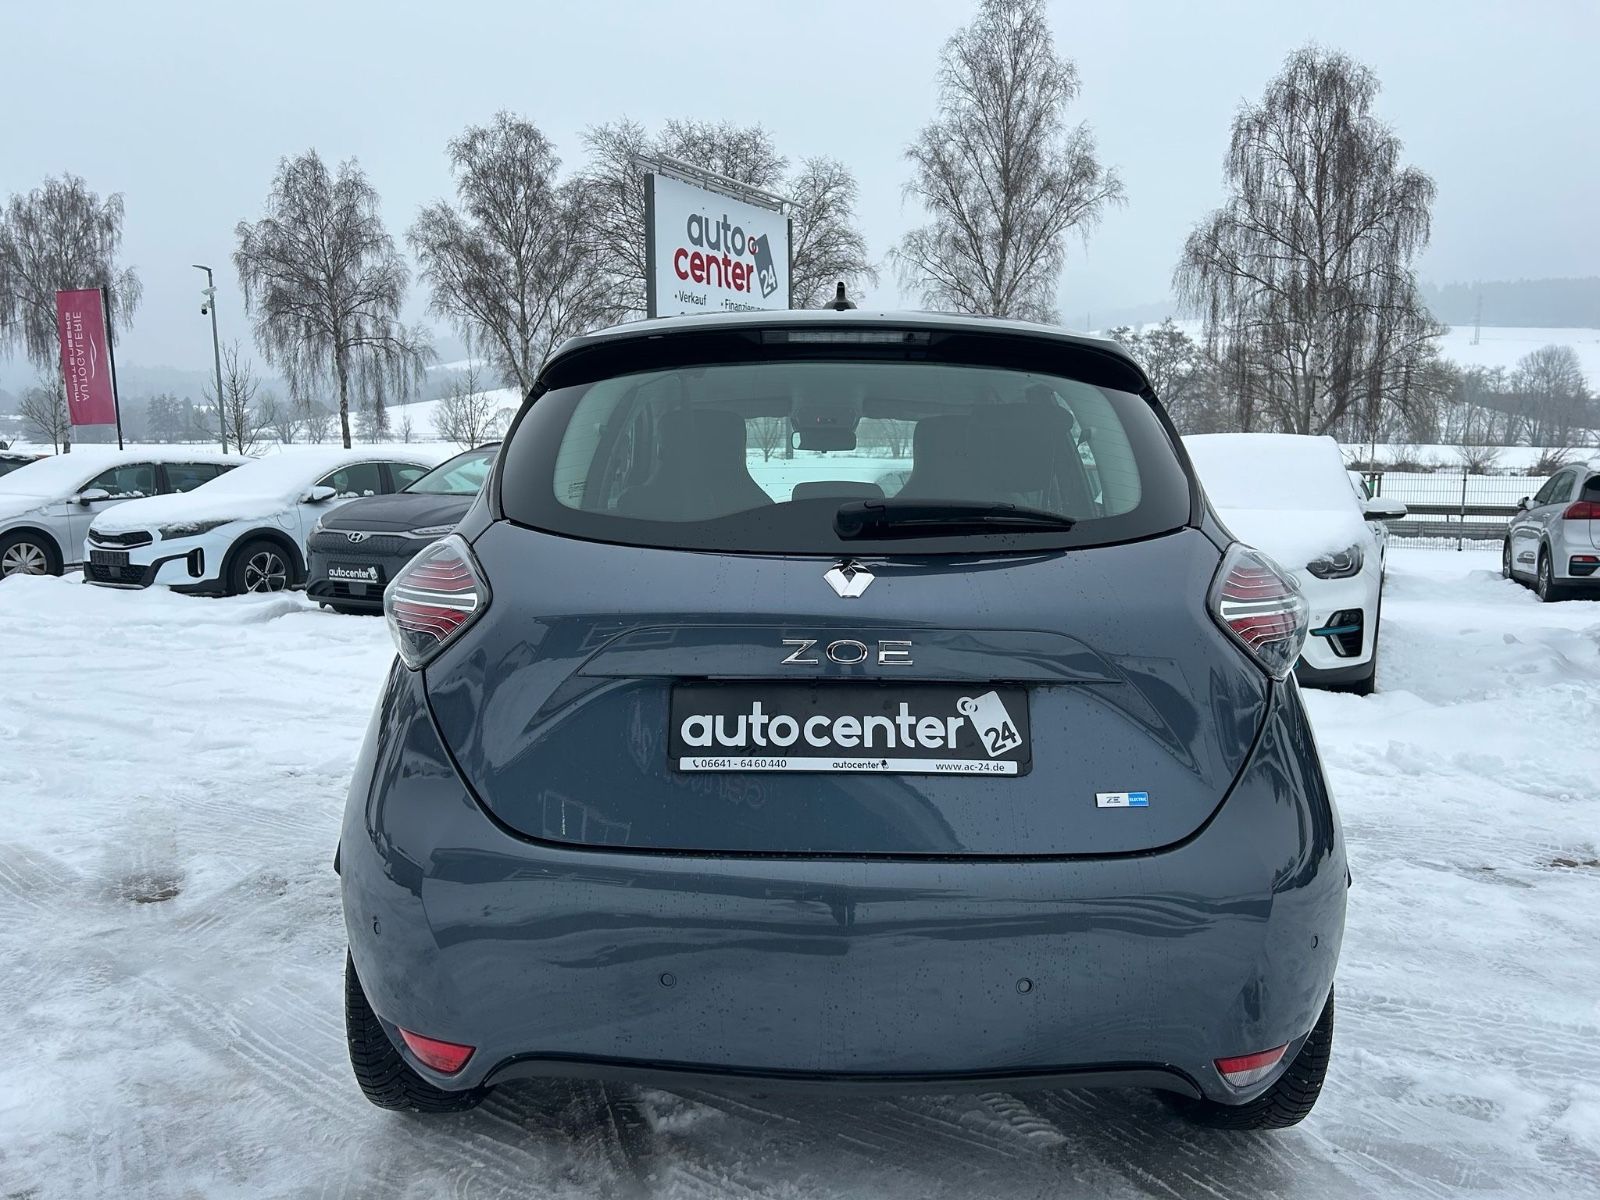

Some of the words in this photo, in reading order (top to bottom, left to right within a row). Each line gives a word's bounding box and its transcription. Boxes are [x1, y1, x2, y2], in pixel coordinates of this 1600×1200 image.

[687, 213, 746, 257] auto
[674, 247, 754, 293] center
[760, 264, 777, 295] 24
[678, 290, 707, 306] Verkauf
[328, 566, 369, 579] autocenter
[780, 639, 913, 665] ZOE
[680, 701, 964, 749] autocenter
[983, 720, 1017, 753] 24
[701, 759, 731, 768] 06641
[832, 760, 879, 769] autocenter
[935, 762, 1005, 773] www.ac-24.de
